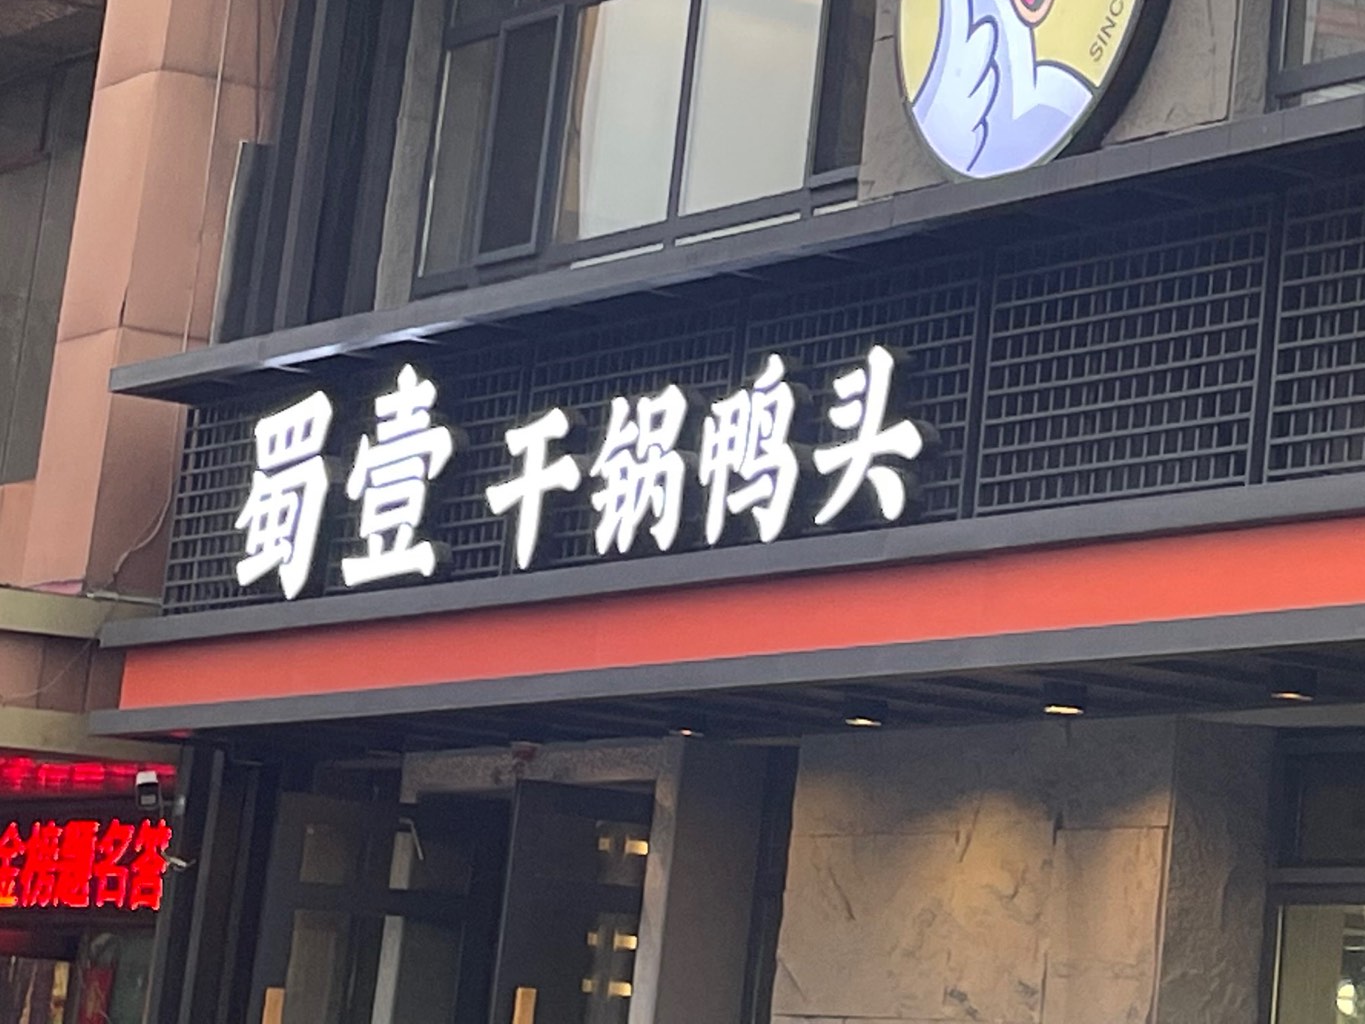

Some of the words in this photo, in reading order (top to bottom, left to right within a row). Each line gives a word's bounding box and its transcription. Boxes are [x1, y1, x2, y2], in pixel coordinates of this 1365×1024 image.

[234, 364, 454, 600] 蜀壹
[486, 345, 923, 570] 干锅鸭头
